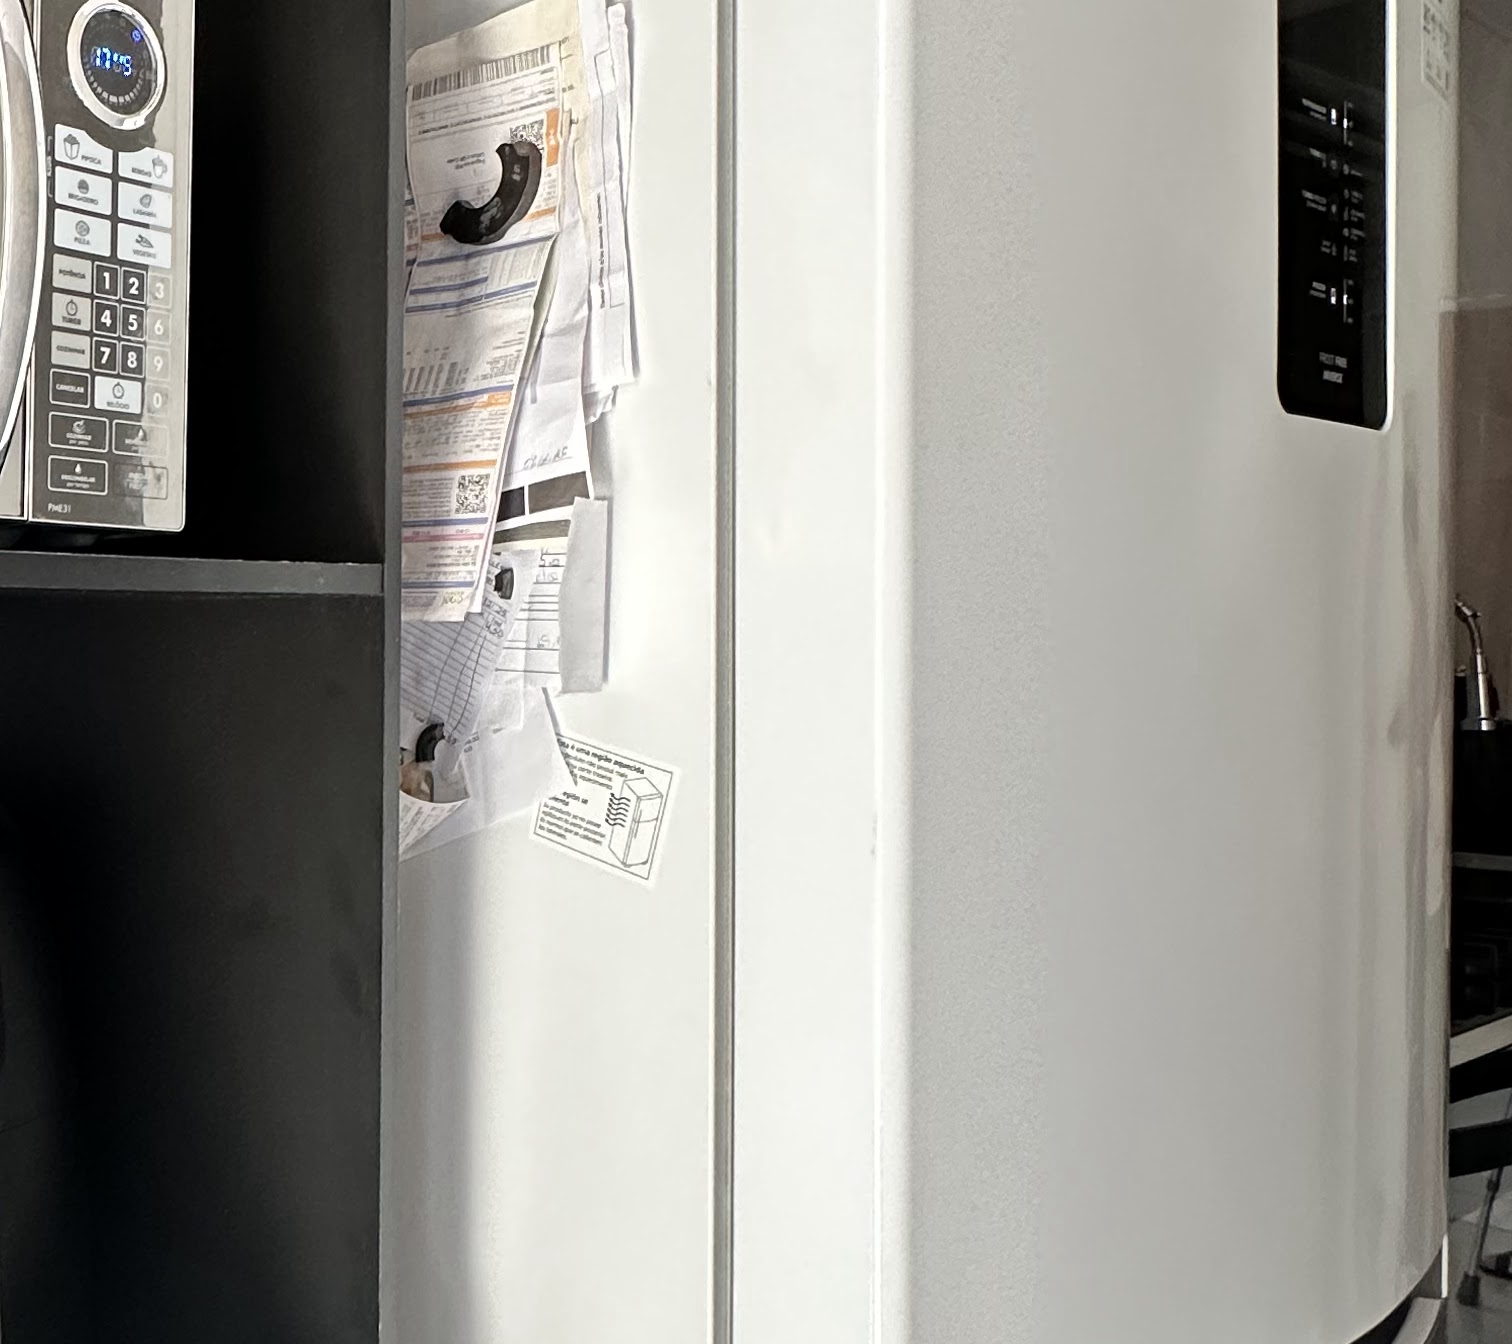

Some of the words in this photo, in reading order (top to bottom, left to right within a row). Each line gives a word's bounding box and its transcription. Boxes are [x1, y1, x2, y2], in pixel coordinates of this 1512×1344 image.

[73, 236, 91, 246] PIZZA
[103, 272, 111, 290] 1
[128, 277, 140, 295] 2
[154, 282, 165, 299] 3
[100, 309, 112, 328] 4
[128, 314, 139, 331] 5
[153, 319, 164, 335] 6
[99, 346, 112, 364] 7
[127, 351, 138, 369] 8
[153, 356, 164, 373] 9
[152, 392, 163, 409] 0
[562, 791, 581, 803] egión
